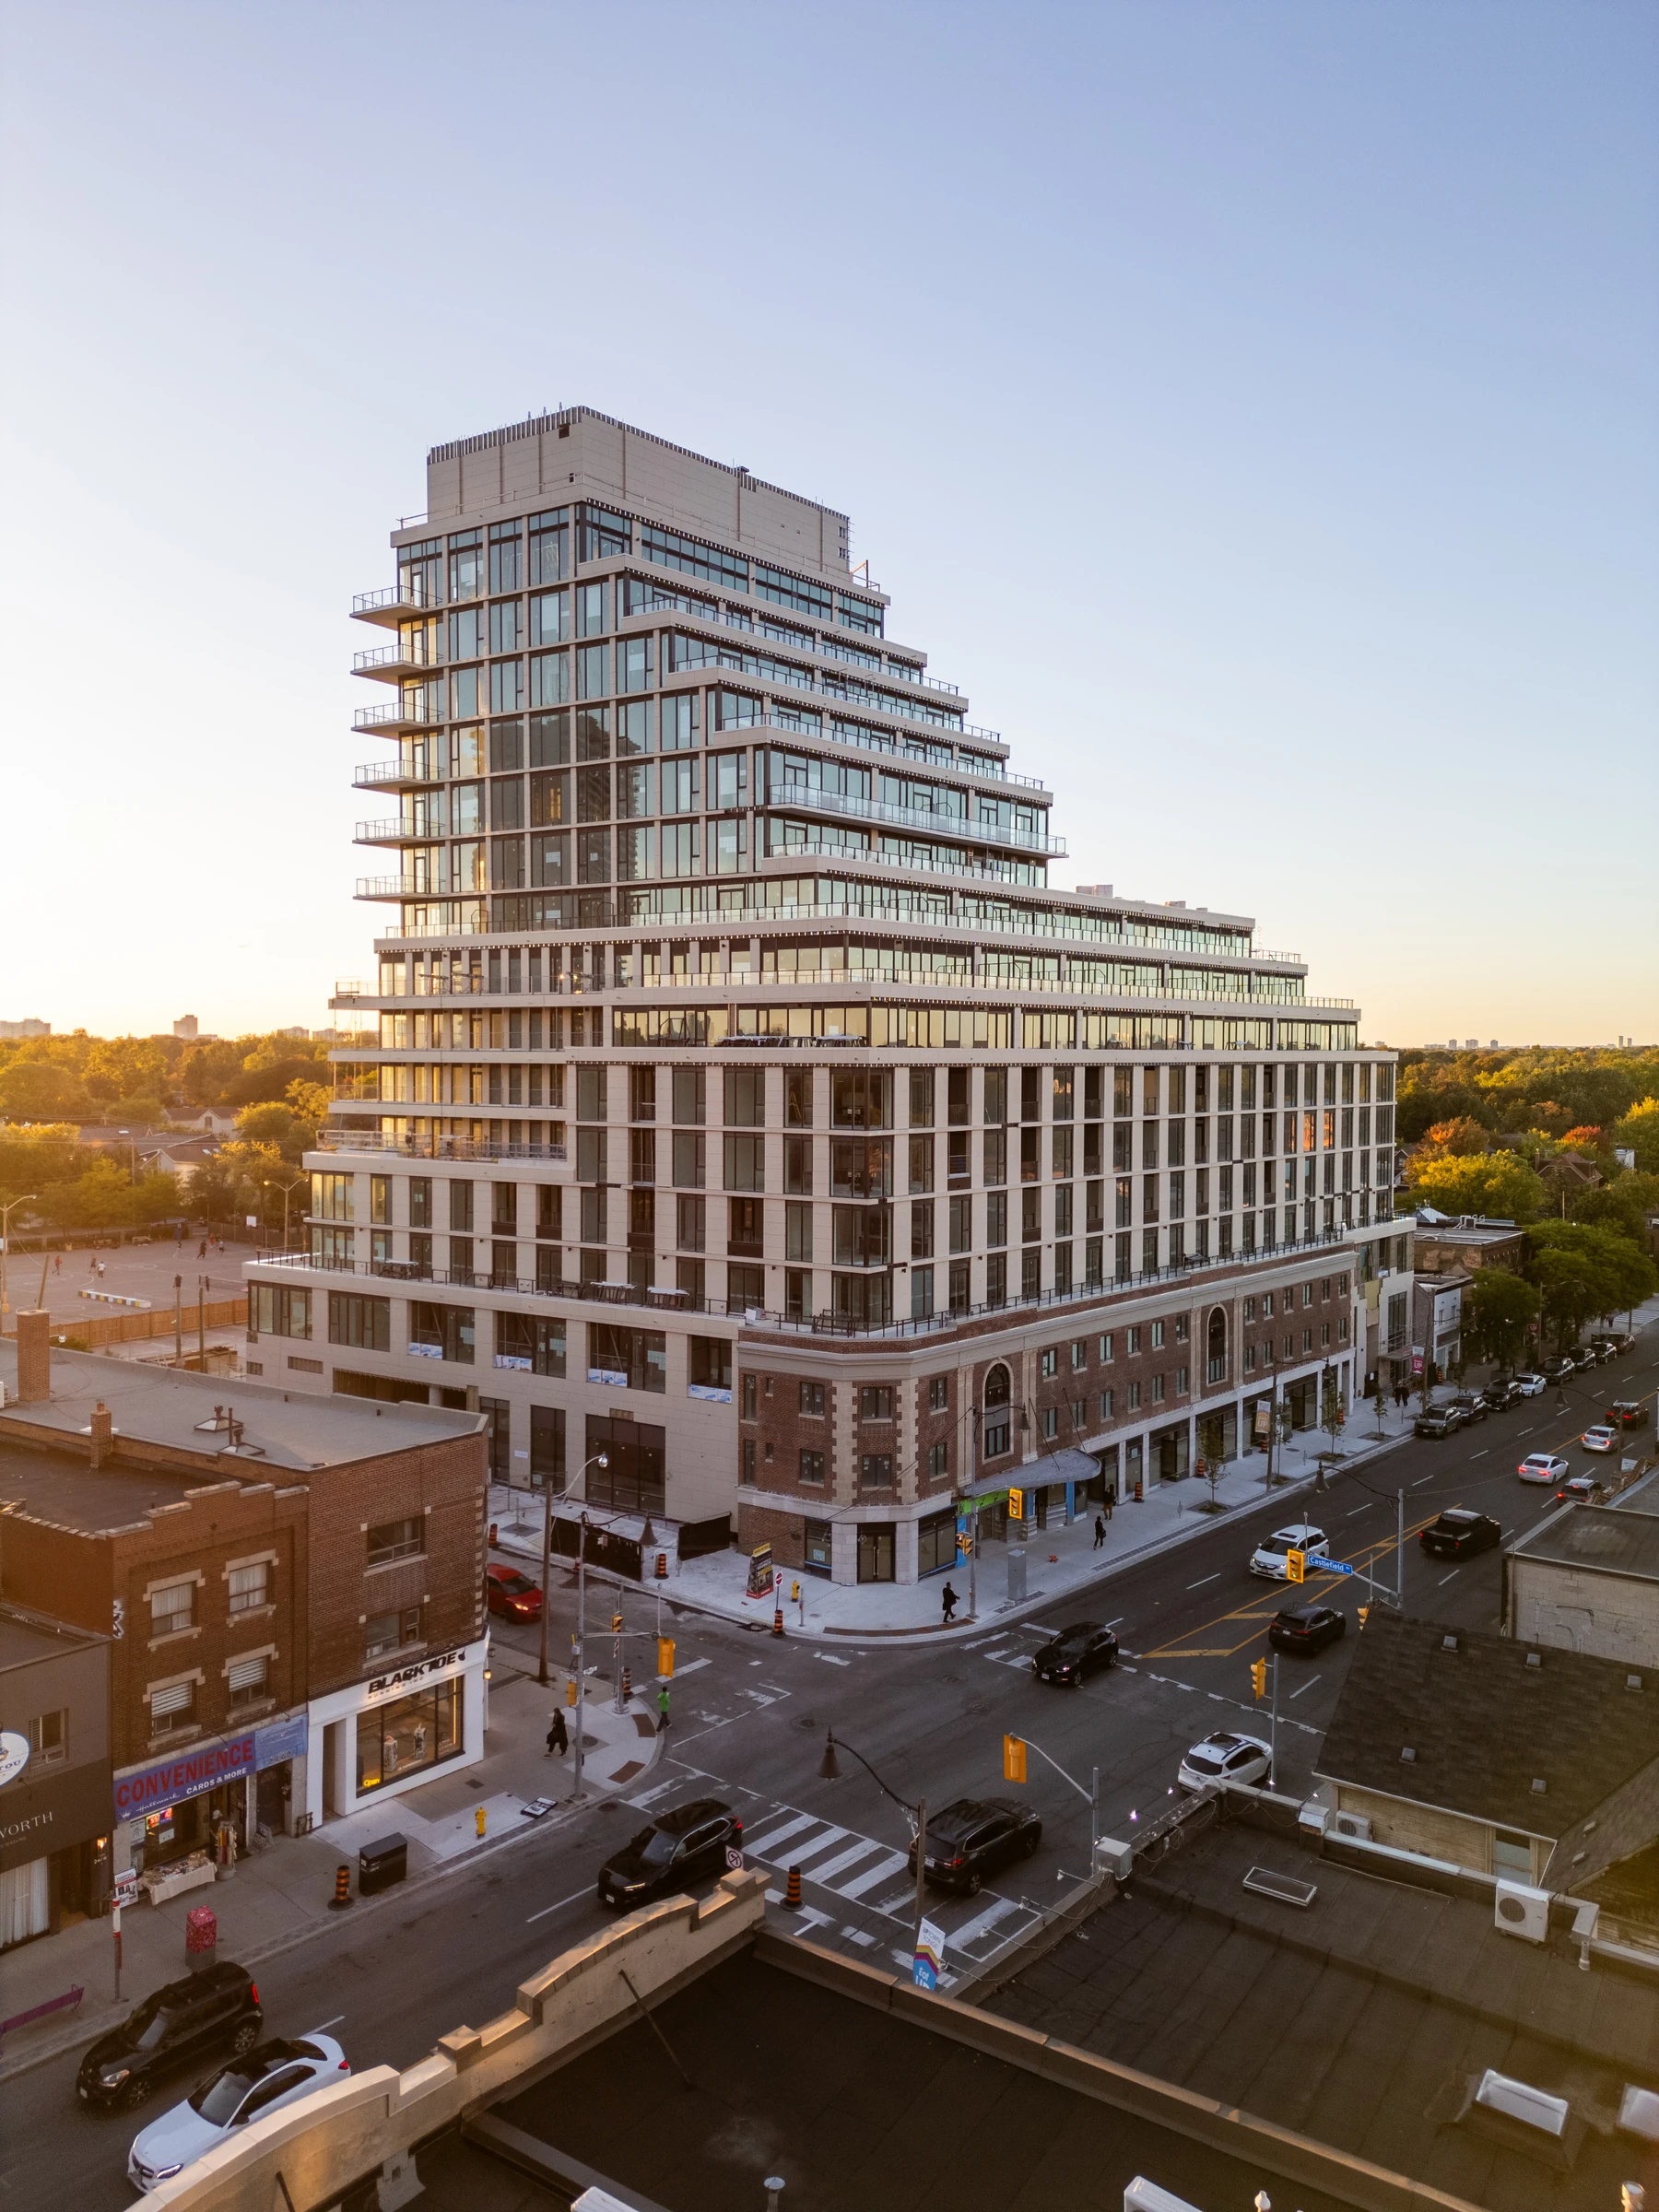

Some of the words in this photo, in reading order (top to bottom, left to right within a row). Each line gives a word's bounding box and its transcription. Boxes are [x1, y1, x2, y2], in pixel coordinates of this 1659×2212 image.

[1310, 1557, 1344, 1571] Castlefield
[368, 1652, 457, 1694] BLACKTOE
[116, 1739, 253, 1807] CONVENIENCE
[363, 1778, 381, 1787] Open
[136, 1792, 181, 1812] Hallmark
[186, 1779, 215, 1794] CARDS
[217, 1775, 223, 1783] &
[224, 1767, 247, 1780] MORE
[918, 1967, 930, 1982] Eat
